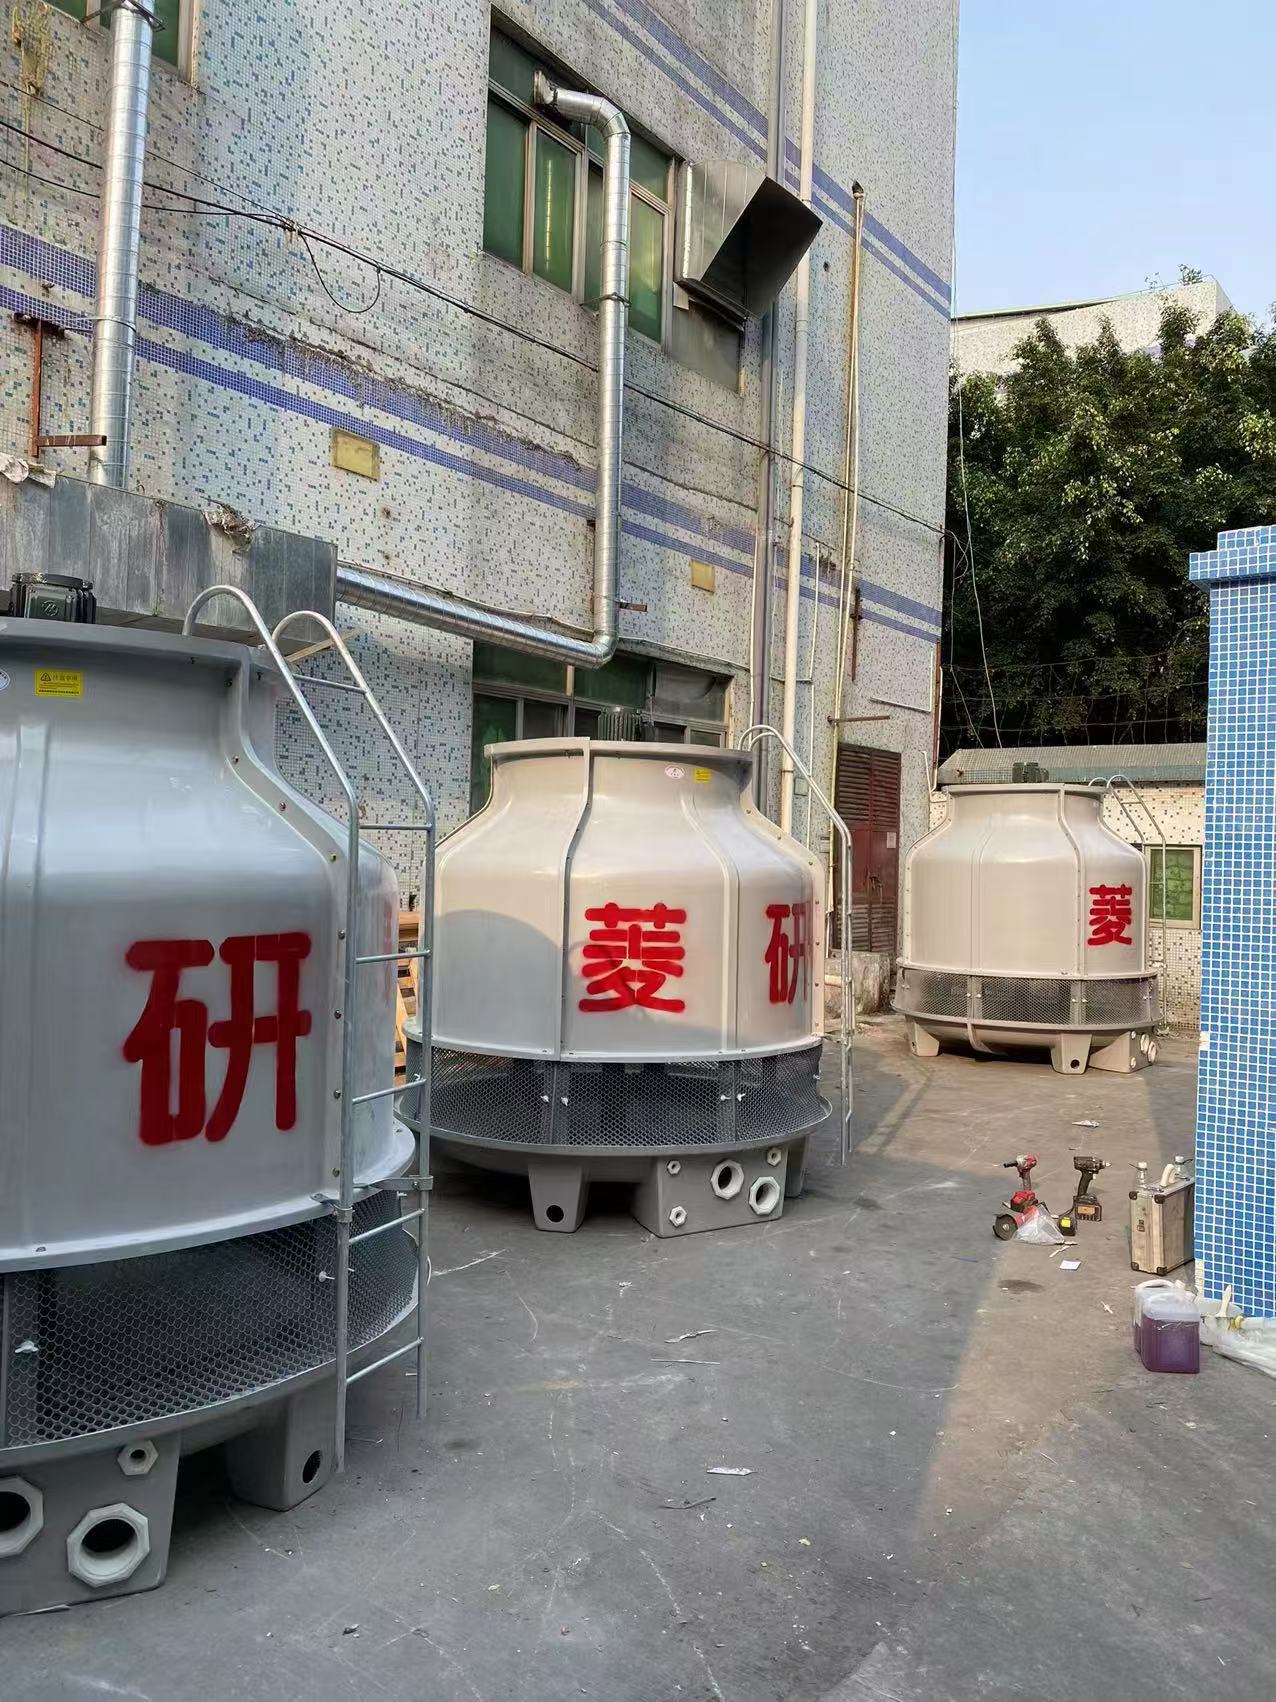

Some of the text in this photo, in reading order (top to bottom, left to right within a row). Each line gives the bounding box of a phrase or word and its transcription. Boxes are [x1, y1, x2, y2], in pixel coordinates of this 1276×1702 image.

[578, 902, 806, 1014] 菱 研
[1087, 883, 1133, 946] 菱
[123, 931, 312, 1145] 研
